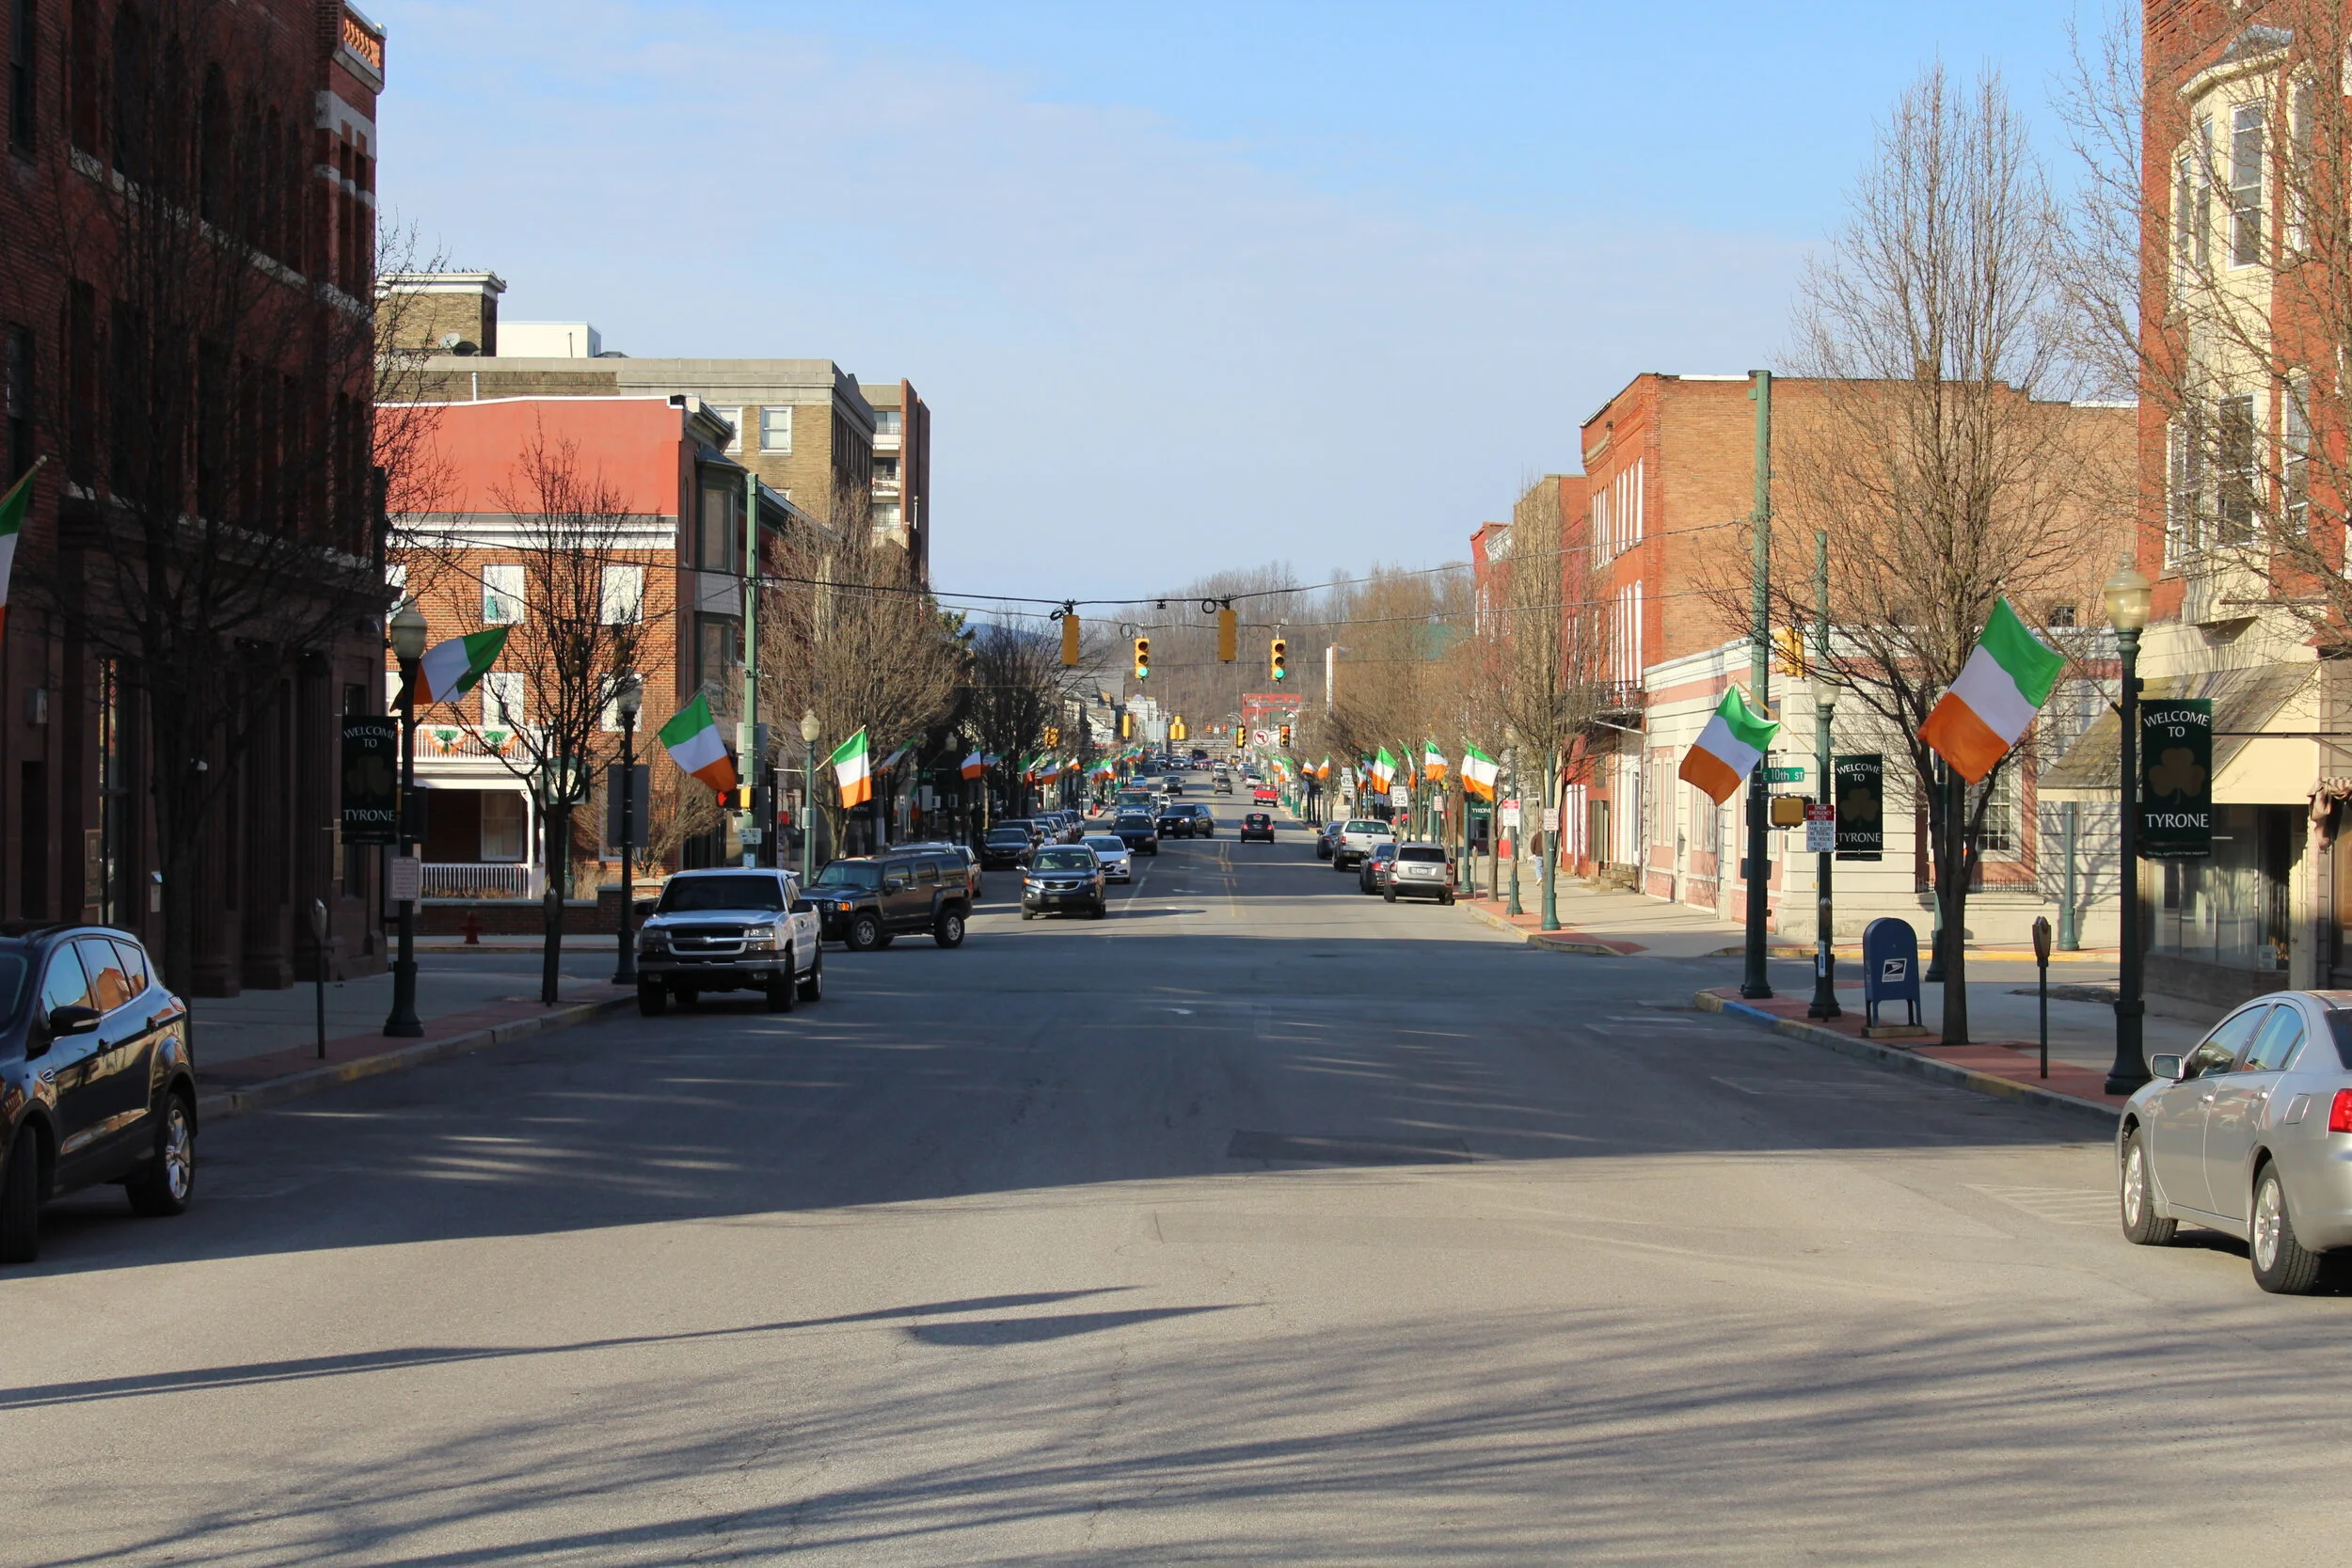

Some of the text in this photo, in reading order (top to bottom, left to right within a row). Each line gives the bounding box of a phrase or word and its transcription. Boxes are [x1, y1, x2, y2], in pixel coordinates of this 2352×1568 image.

[2143, 710, 2210, 727] WELCOME
[343, 725, 396, 741] WELCOME
[2168, 726, 2185, 737] TO
[363, 738, 377, 748] TO
[1762, 768, 1804, 781] E 10th ST
[1836, 763, 1881, 775] WELCOME
[1852, 773, 1865, 782] TO
[343, 809, 396, 822] TYRONE
[2145, 814, 2209, 828] TYRONE
[1837, 832, 1882, 843] TYRONE
